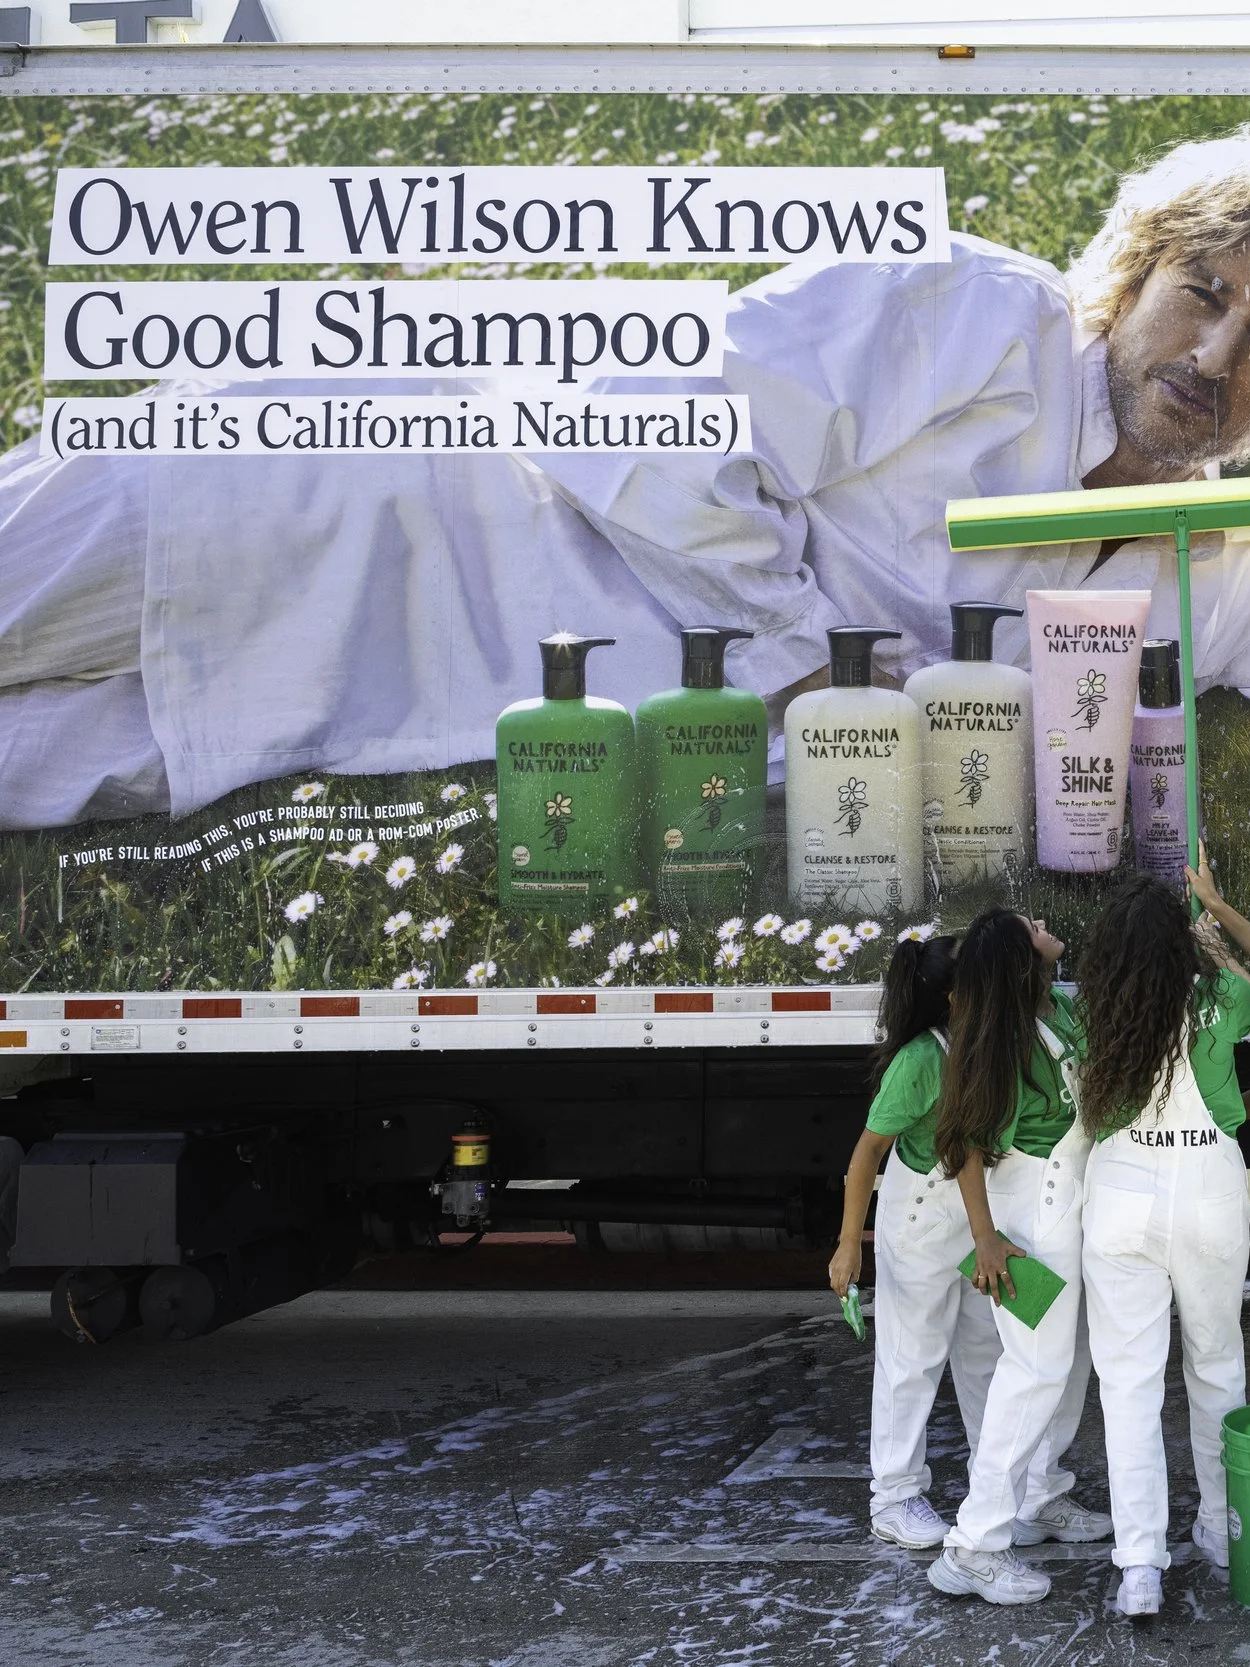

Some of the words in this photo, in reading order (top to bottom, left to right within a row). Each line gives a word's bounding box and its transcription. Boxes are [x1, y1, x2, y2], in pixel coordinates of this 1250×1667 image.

[69, 177, 305, 256] Owen
[329, 172, 619, 255] Wilson
[646, 177, 928, 255] Knows
[64, 286, 283, 370] Good
[311, 286, 711, 384] Shampoo
[51, 400, 157, 460] (and
[173, 402, 240, 450] it's
[257, 399, 498, 449] California
[512, 398, 739, 457] Naturals)
[1043, 624, 1137, 639] CALIFORNIA
[925, 700, 1022, 717] CALIFORNIA
[665, 723, 758, 741] CALIFORNIA
[801, 727, 900, 743] CALIFORNIA
[508, 741, 609, 758] CALIFORNIA
[1061, 756, 1101, 774] SILK
[1103, 757, 1114, 774] &
[1061, 775, 1114, 793] SHINE
[58, 854, 69, 869] IF
[73, 847, 115, 867] YOU'RE
[118, 845, 150, 862] STILL
[153, 838, 203, 861] READING
[202, 824, 235, 851] THIS,
[232, 808, 275, 832] YOU'RE
[277, 805, 336, 821] PROBABLY
[339, 805, 371, 820] STILL
[374, 801, 425, 820] DECIDING
[964, 826, 971, 835] &
[973, 825, 1013, 835] RESTORE
[200, 857, 214, 874] IF
[214, 844, 241, 868] THIS
[241, 836, 255, 853] IS
[257, 832, 267, 847] A
[269, 826, 326, 843] SHAMPOO
[328, 827, 345, 843] AD
[347, 826, 363, 842] OR
[365, 826, 375, 841] A
[378, 822, 433, 842] ROM-COM
[435, 807, 483, 832] POSTER.
[804, 855, 843, 865] CLEANSE
[845, 856, 852, 865] &
[854, 854, 897, 865] RESTORE
[1129, 1128, 1175, 1148] CLEAN
[1180, 1127, 1219, 1146] TEAM
